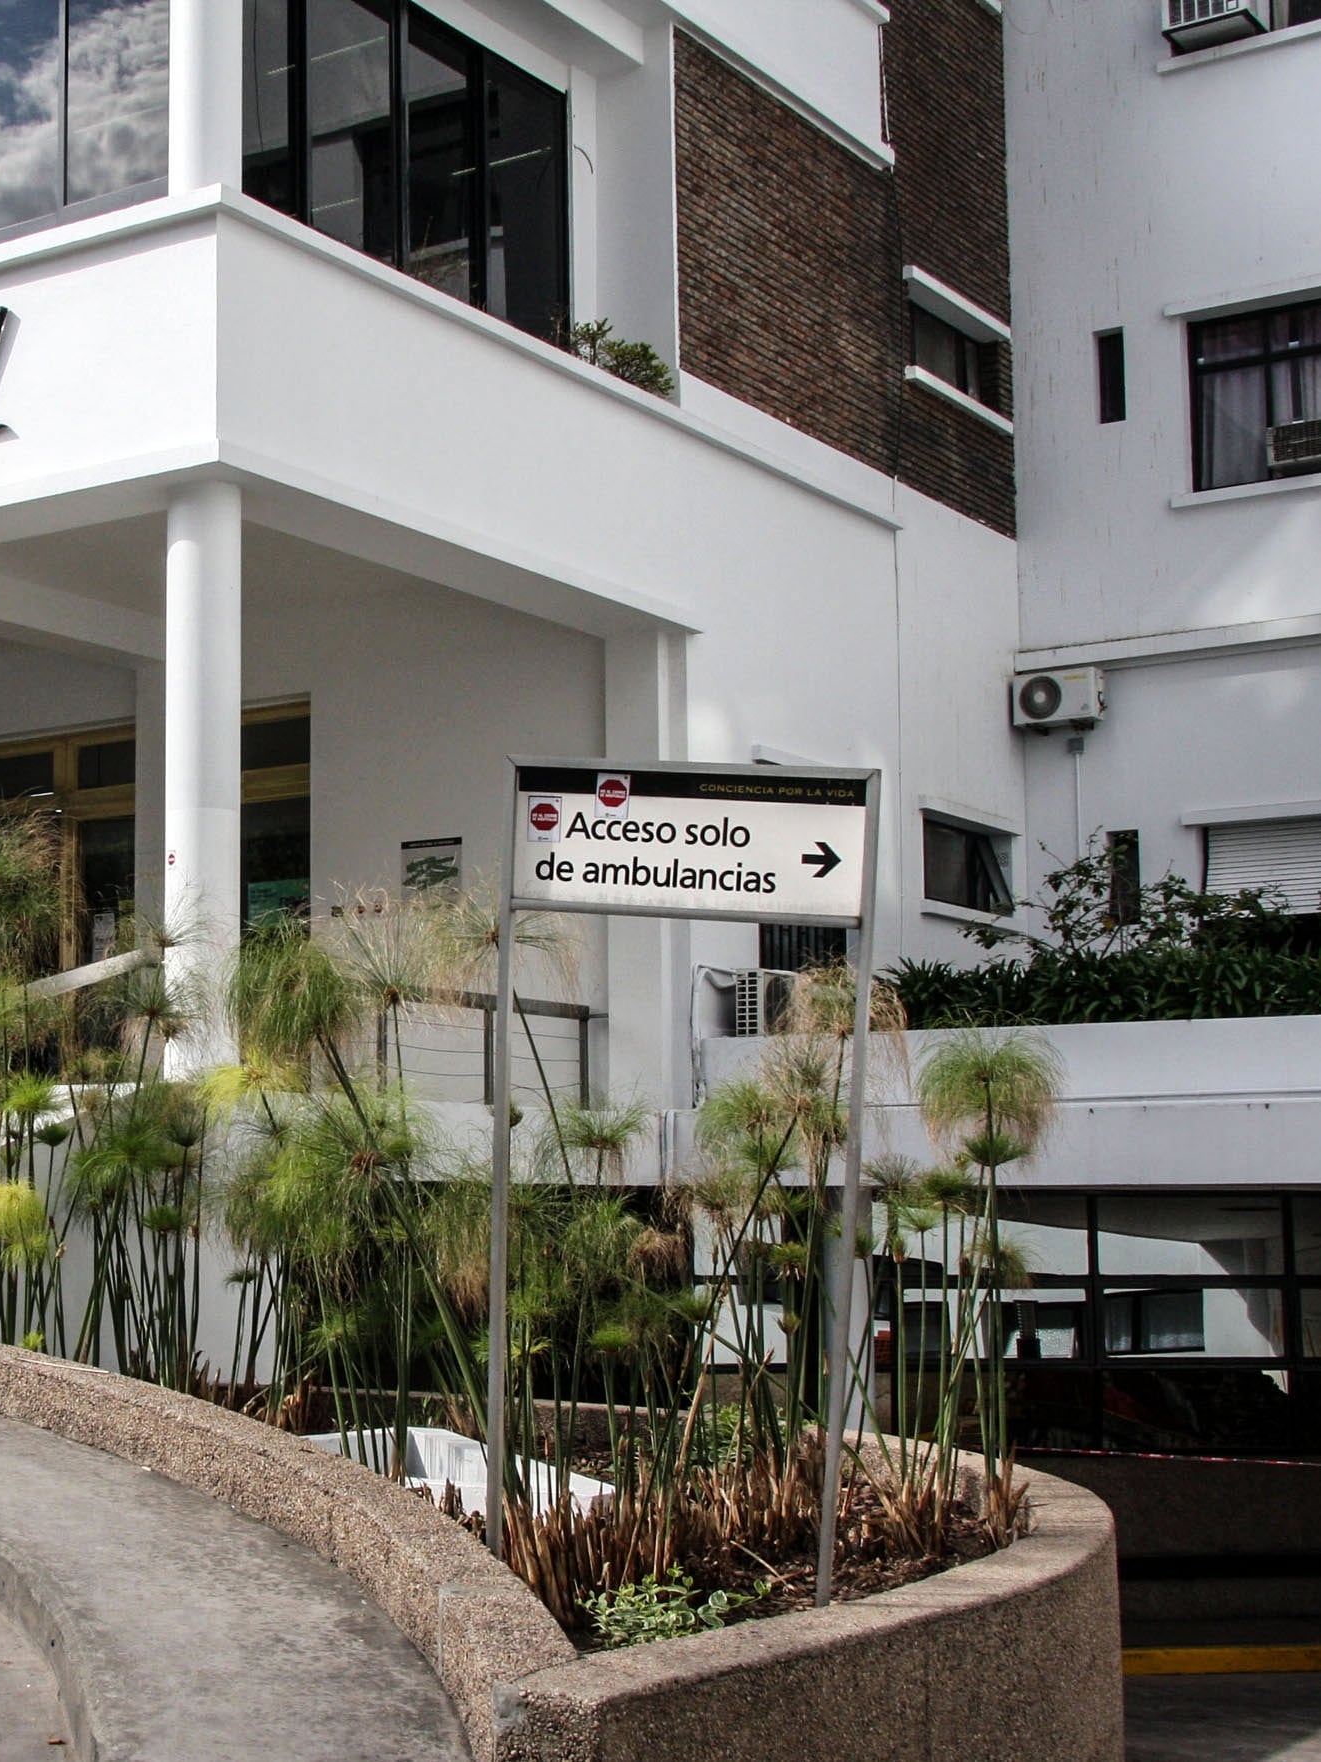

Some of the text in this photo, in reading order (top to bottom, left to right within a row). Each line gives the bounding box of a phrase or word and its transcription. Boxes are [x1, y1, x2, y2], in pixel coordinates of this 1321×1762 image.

[699, 783, 855, 798] CONCIENCIA POR LA VIDA
[565, 811, 751, 848] Acceso solo
[535, 852, 776, 893] de ambulancias
